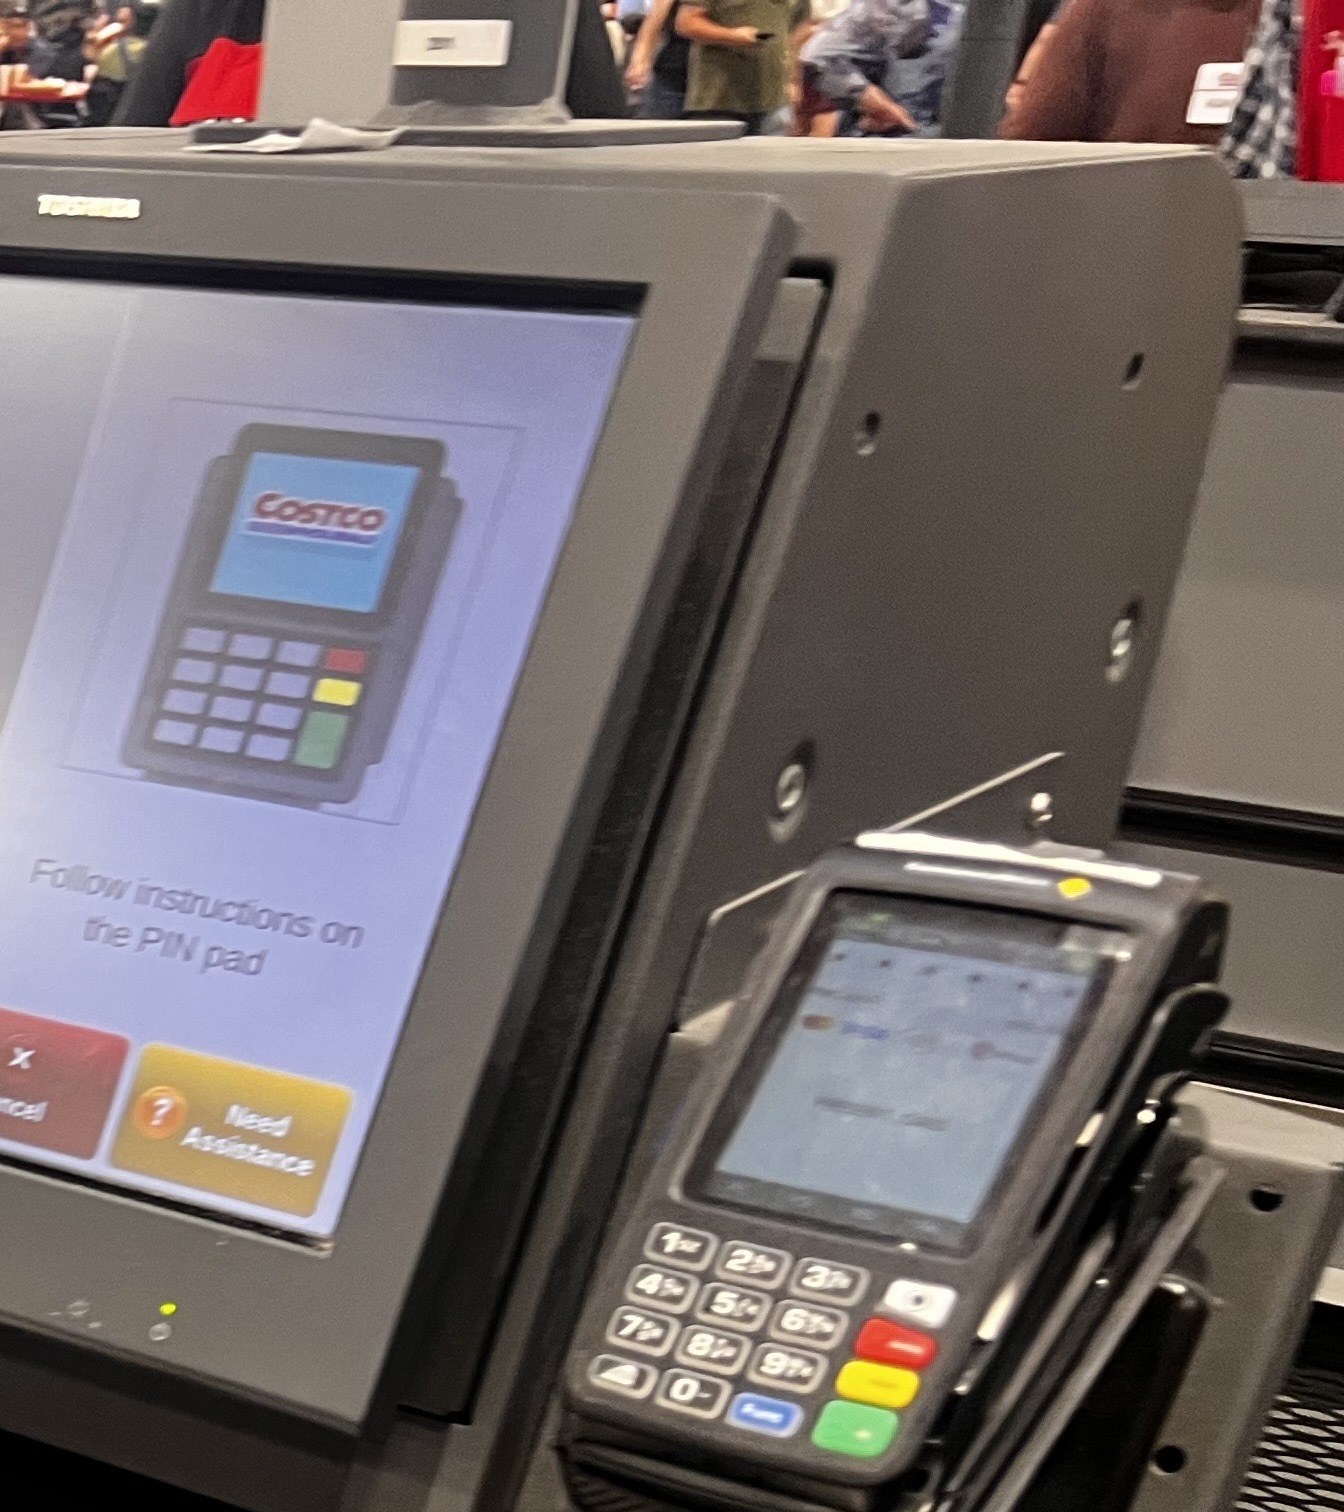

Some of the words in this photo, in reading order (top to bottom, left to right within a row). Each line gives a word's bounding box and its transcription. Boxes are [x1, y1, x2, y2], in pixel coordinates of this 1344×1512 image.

[254, 491, 385, 531] COSTCO
[29, 858, 131, 900] Follow
[133, 878, 313, 938] instructions
[319, 920, 365, 949] on
[83, 915, 132, 947] the
[134, 926, 200, 962] PIN
[198, 944, 269, 976] pad
[224, 1104, 293, 1137] Need
[179, 1126, 316, 1176] Assistance
